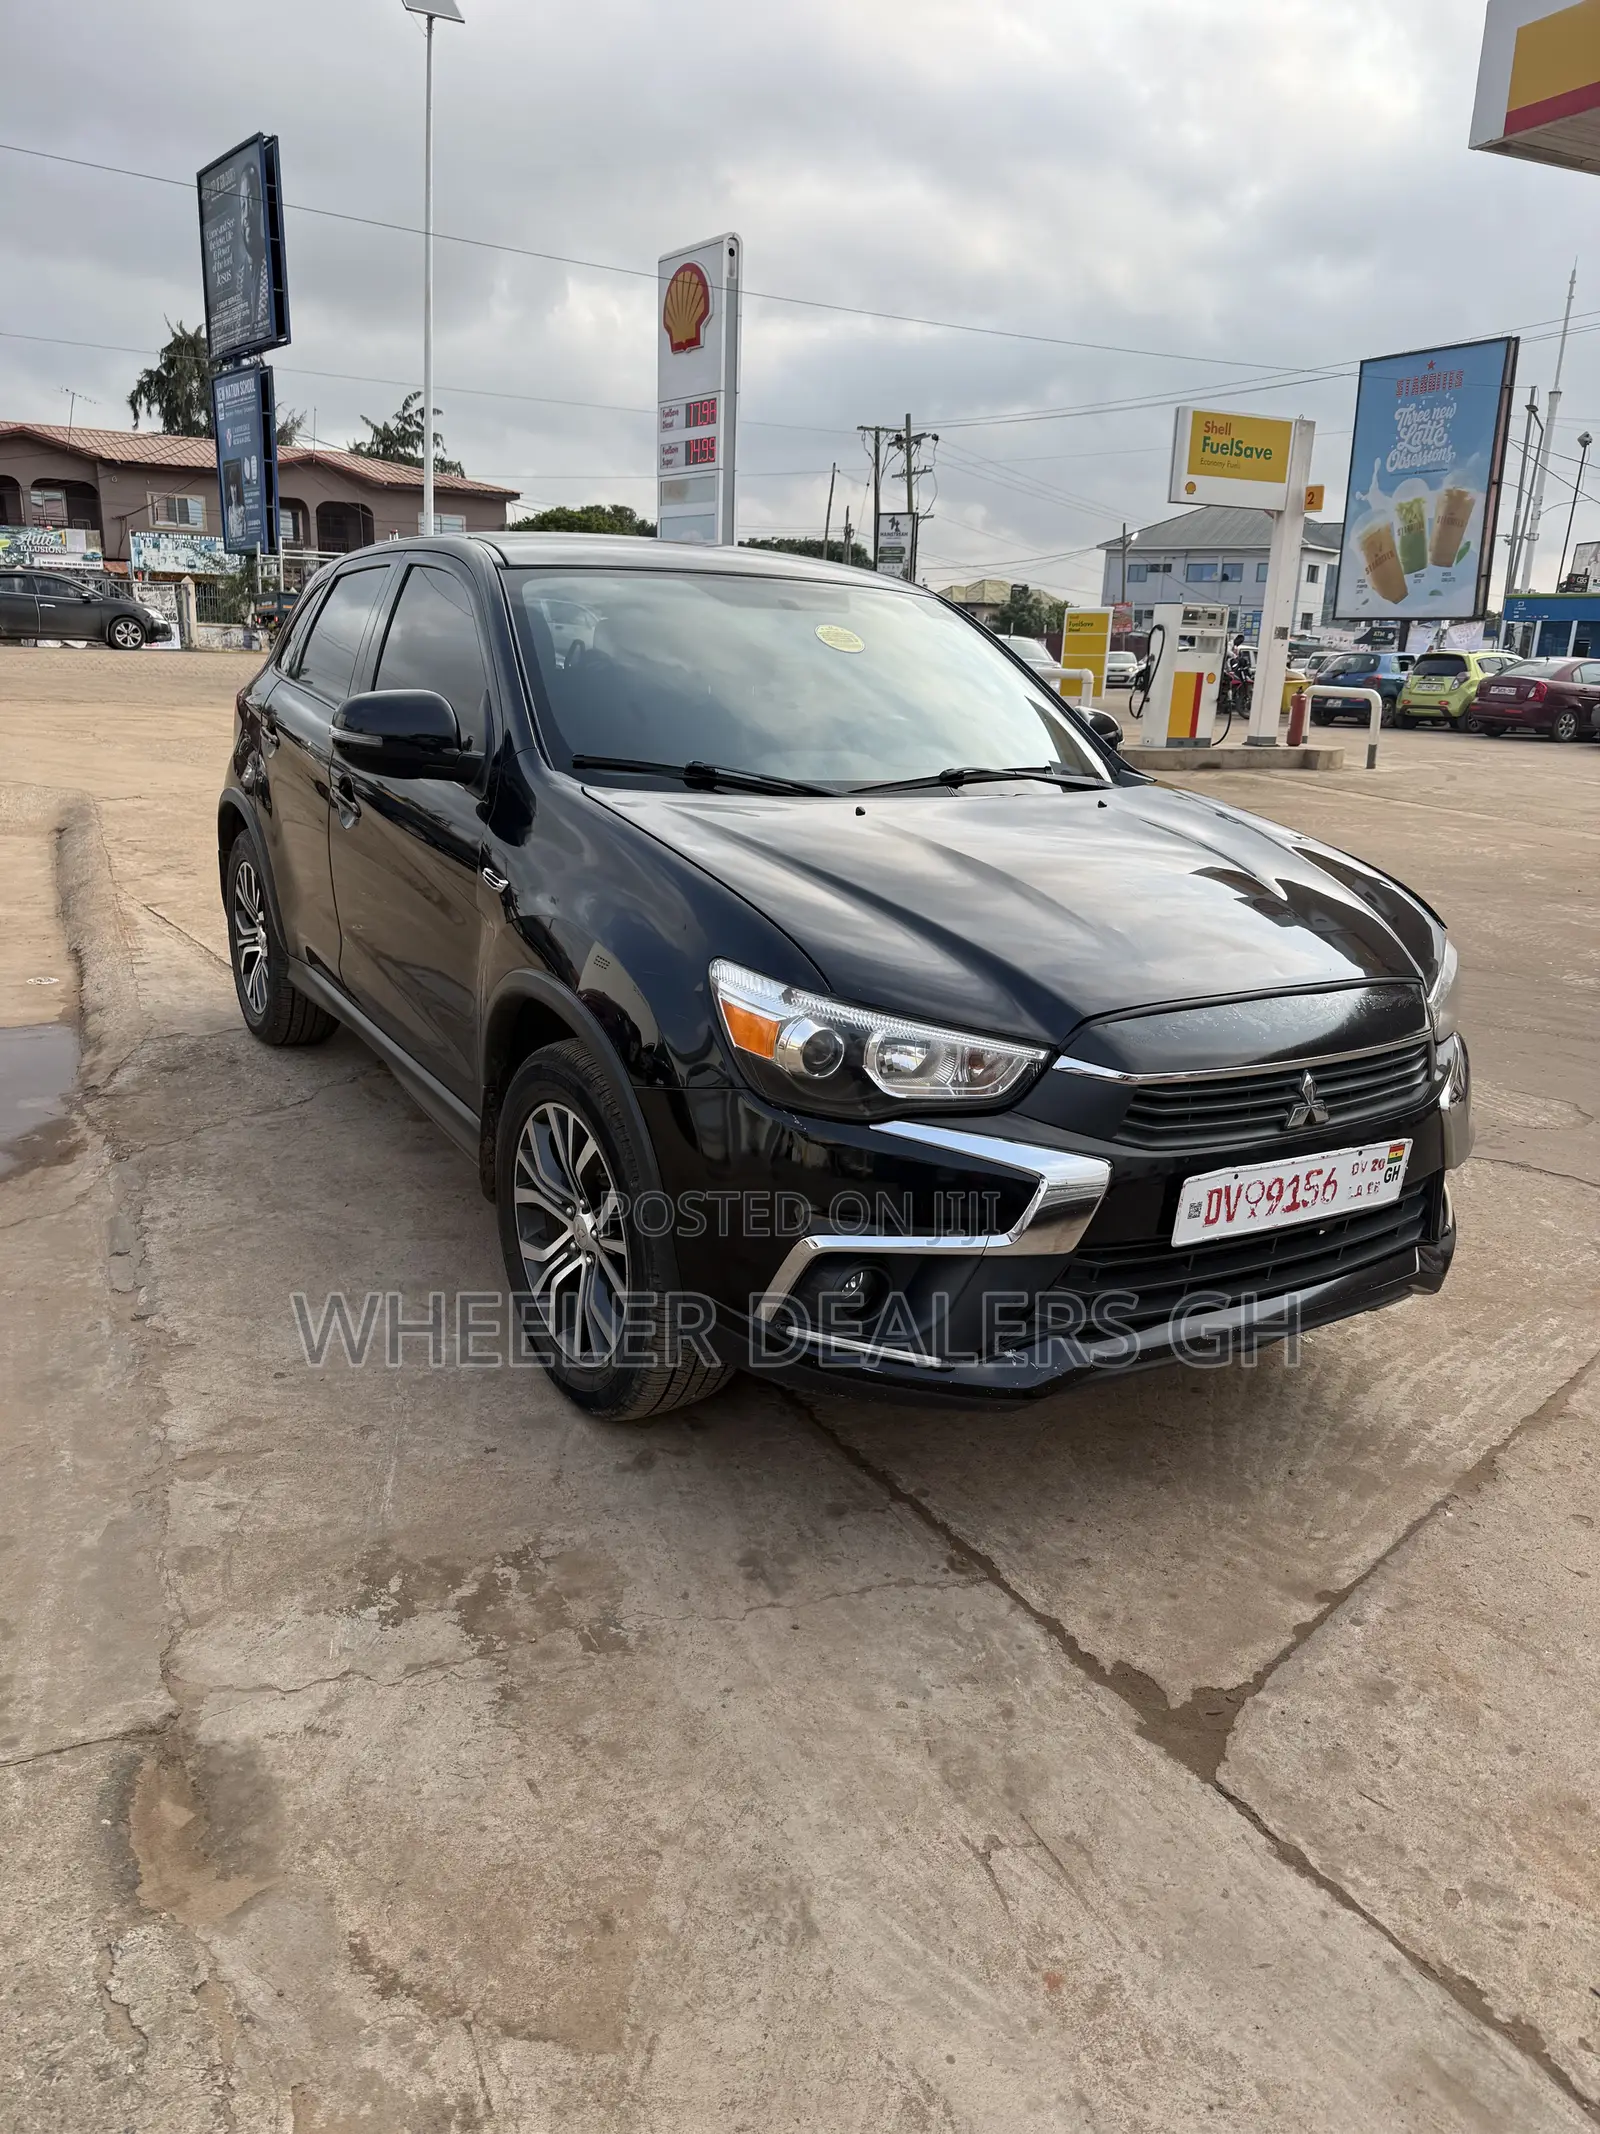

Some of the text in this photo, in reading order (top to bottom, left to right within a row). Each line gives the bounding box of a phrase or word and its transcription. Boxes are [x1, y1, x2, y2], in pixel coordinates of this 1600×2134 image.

[1394, 402, 1457, 431] Three new
[1203, 420, 1232, 436] Shell
[1397, 420, 1448, 453] Latte
[1201, 436, 1273, 460] FuelSave
[1200, 457, 1226, 469] Economy
[1307, 492, 1315, 505] 2
[17, 531, 56, 546] Auto
[20, 545, 67, 554] ILLUSIONS
[1383, 1164, 1401, 1184] GH
